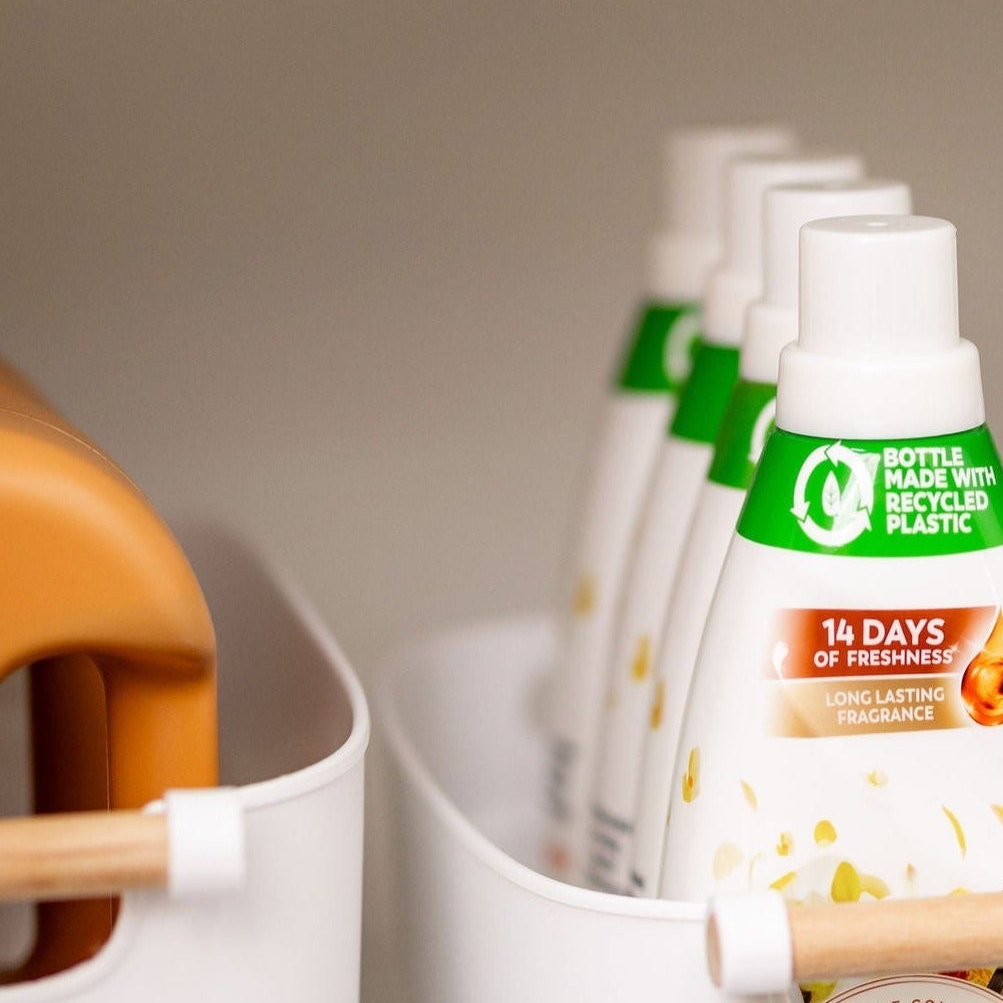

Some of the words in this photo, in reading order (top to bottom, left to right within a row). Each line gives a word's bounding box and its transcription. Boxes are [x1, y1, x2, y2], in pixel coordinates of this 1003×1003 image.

[883, 447, 963, 468] BOTTLE
[885, 468, 948, 489] MADE
[953, 466, 997, 487] WITH
[885, 490, 989, 513] RECYCLED
[887, 513, 972, 534] PLASTIC
[822, 618, 855, 646] 14
[863, 618, 945, 646] DAYS
[813, 650, 839, 668] OF
[847, 648, 953, 668] FRESHNESS
[825, 690, 872, 707] LONG
[875, 687, 945, 705] LASTING
[838, 705, 934, 725] FRAGRANCE
